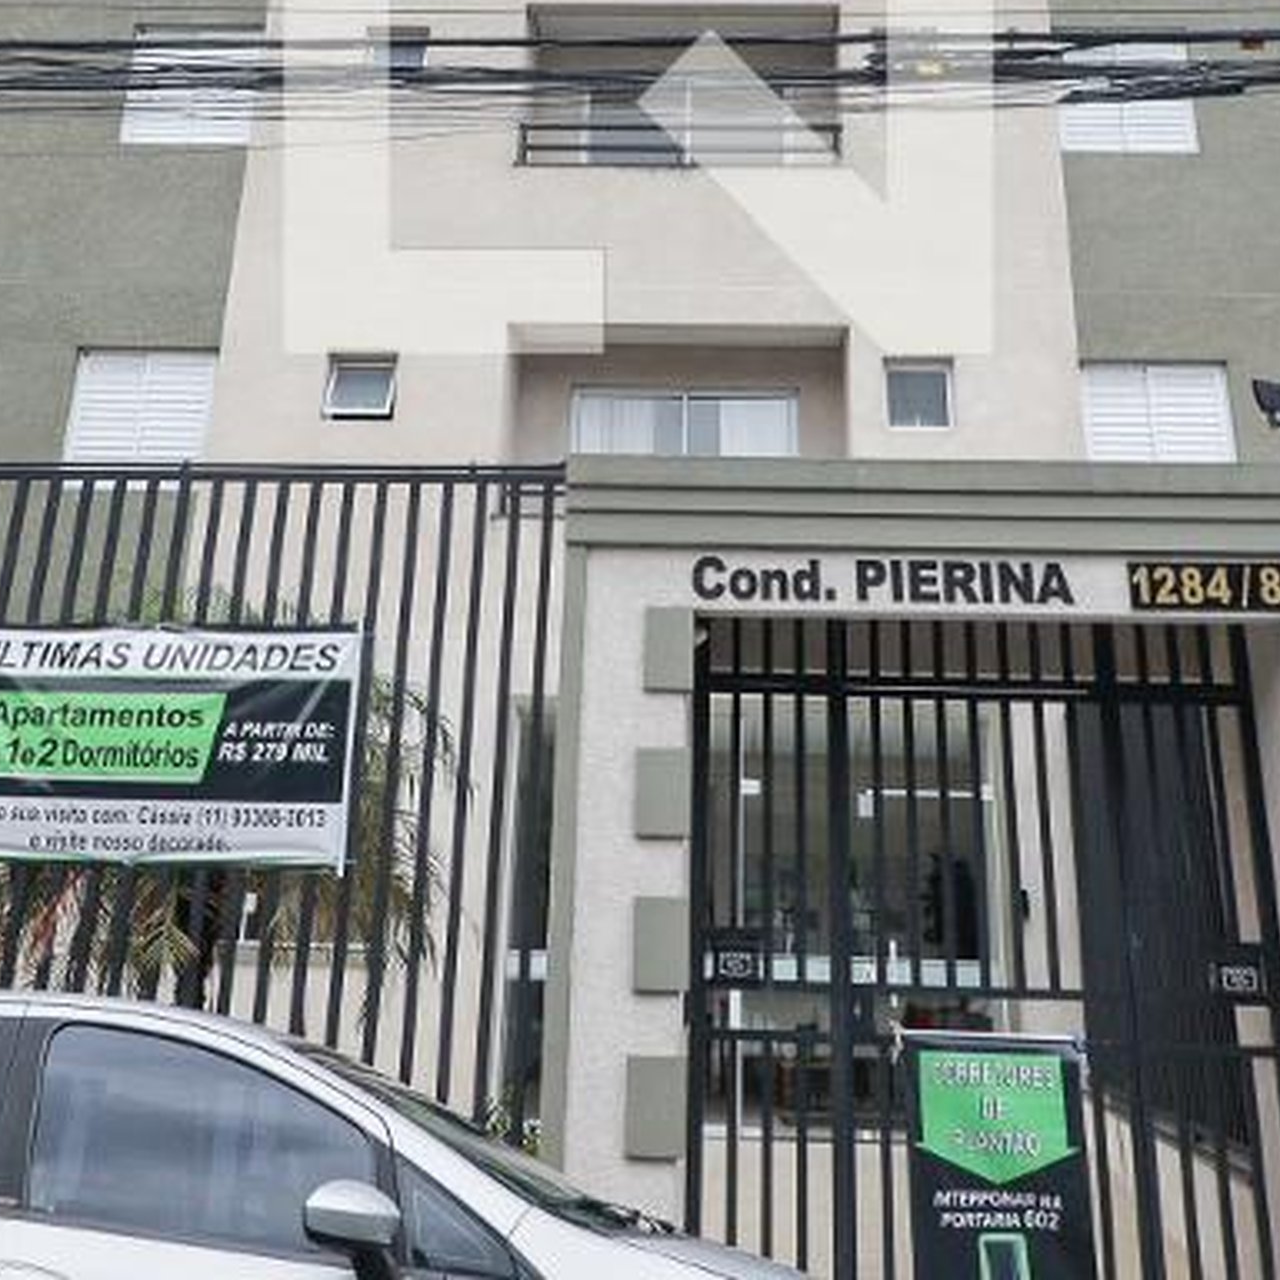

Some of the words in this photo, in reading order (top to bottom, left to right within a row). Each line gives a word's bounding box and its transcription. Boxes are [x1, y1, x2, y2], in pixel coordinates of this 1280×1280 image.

[692, 555, 837, 601] Cond.
[855, 558, 1074, 605] PIERINA
[142, 642, 341, 672] UNIDADES
[222, 722, 237, 738] A
[240, 721, 302, 739] PARTIR
[62, 738, 200, 769] Dormitórios
[218, 741, 247, 761] R$
[292, 742, 329, 762] MIL
[10, 806, 40, 821] sua
[46, 830, 87, 852] visite
[93, 835, 144, 851] nosso
[939, 1211, 1022, 1229] PORTARIA
